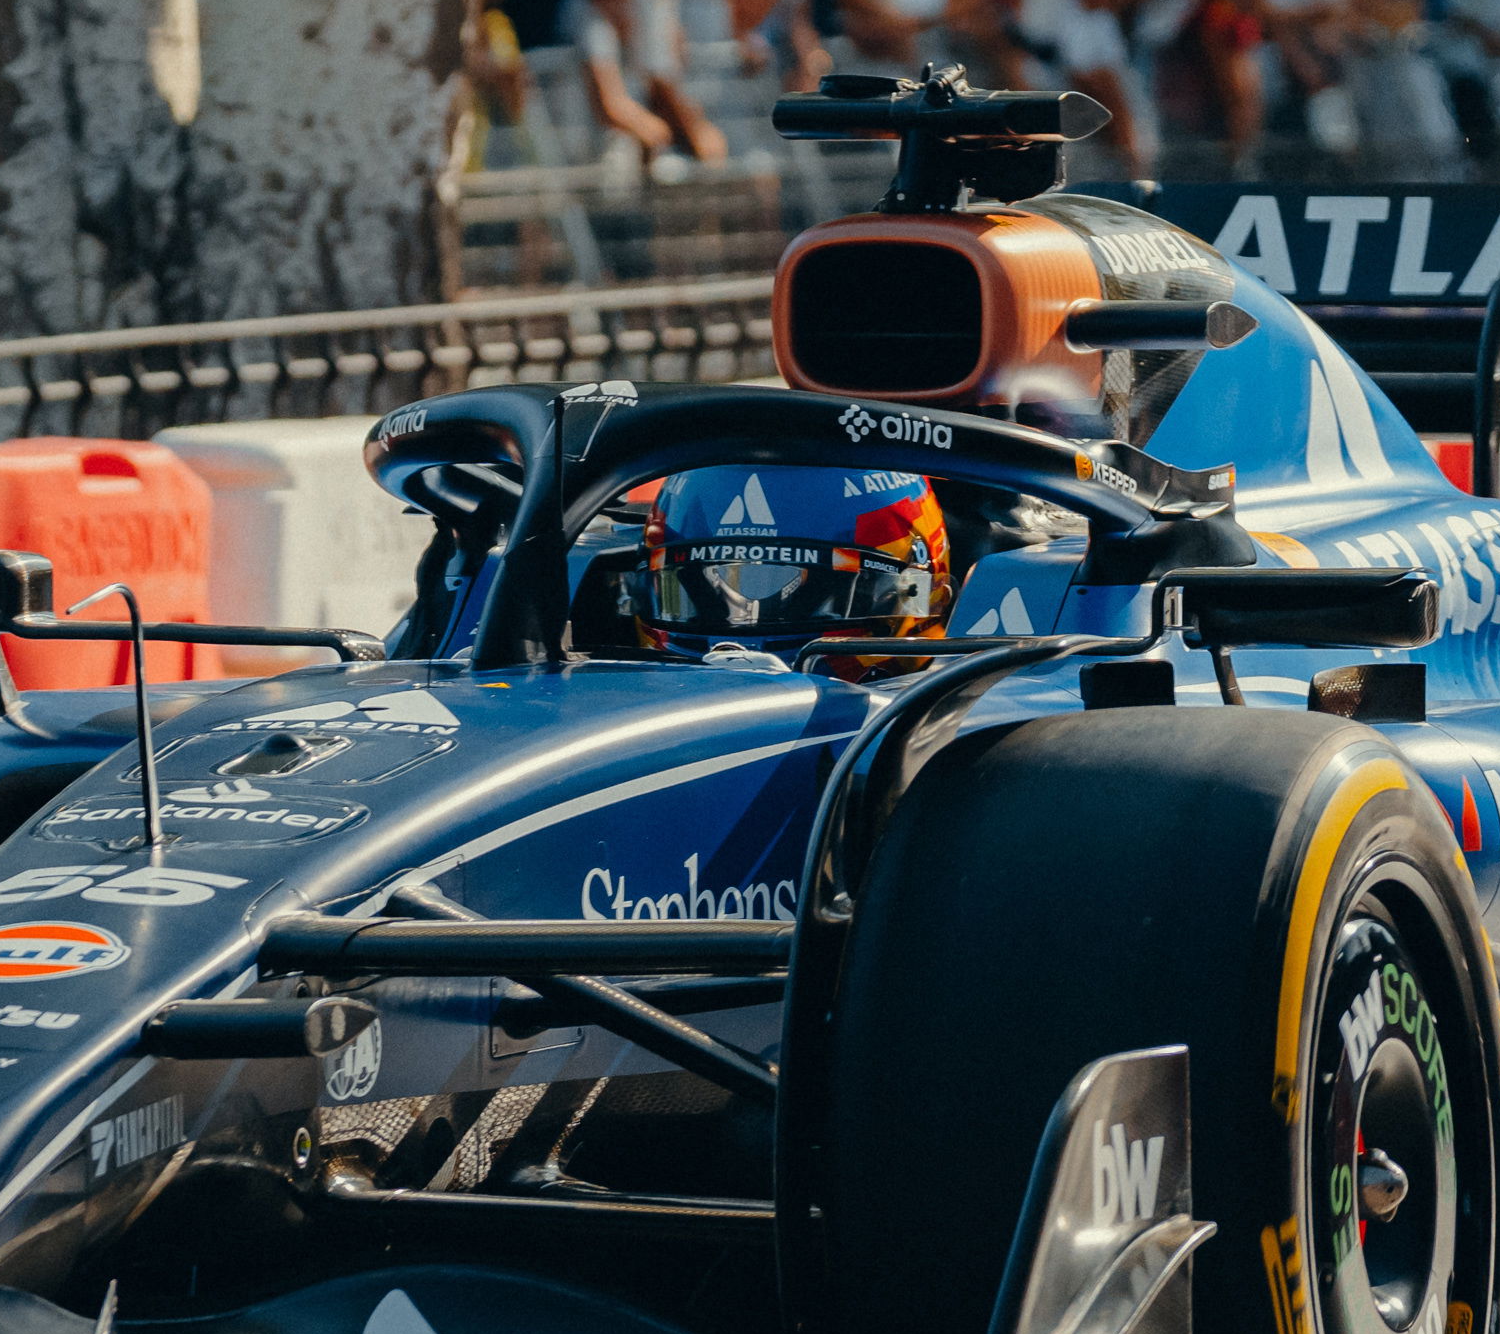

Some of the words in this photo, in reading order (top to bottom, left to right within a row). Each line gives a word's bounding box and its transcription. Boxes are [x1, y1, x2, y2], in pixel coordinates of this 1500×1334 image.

[1089, 229, 1210, 275] DURACELL
[546, 395, 639, 408] ALASSIAN
[881, 411, 953, 450] airia
[864, 470, 921, 494] ATLASS
[1092, 459, 1138, 500] KEEPER
[715, 527, 778, 538] ATLASSIAN
[690, 545, 819, 564] MYPROTEIN
[211, 720, 461, 736] ATLASSIAN
[50, 800, 344, 832] Santander
[1092, 1119, 1165, 1229] bw
